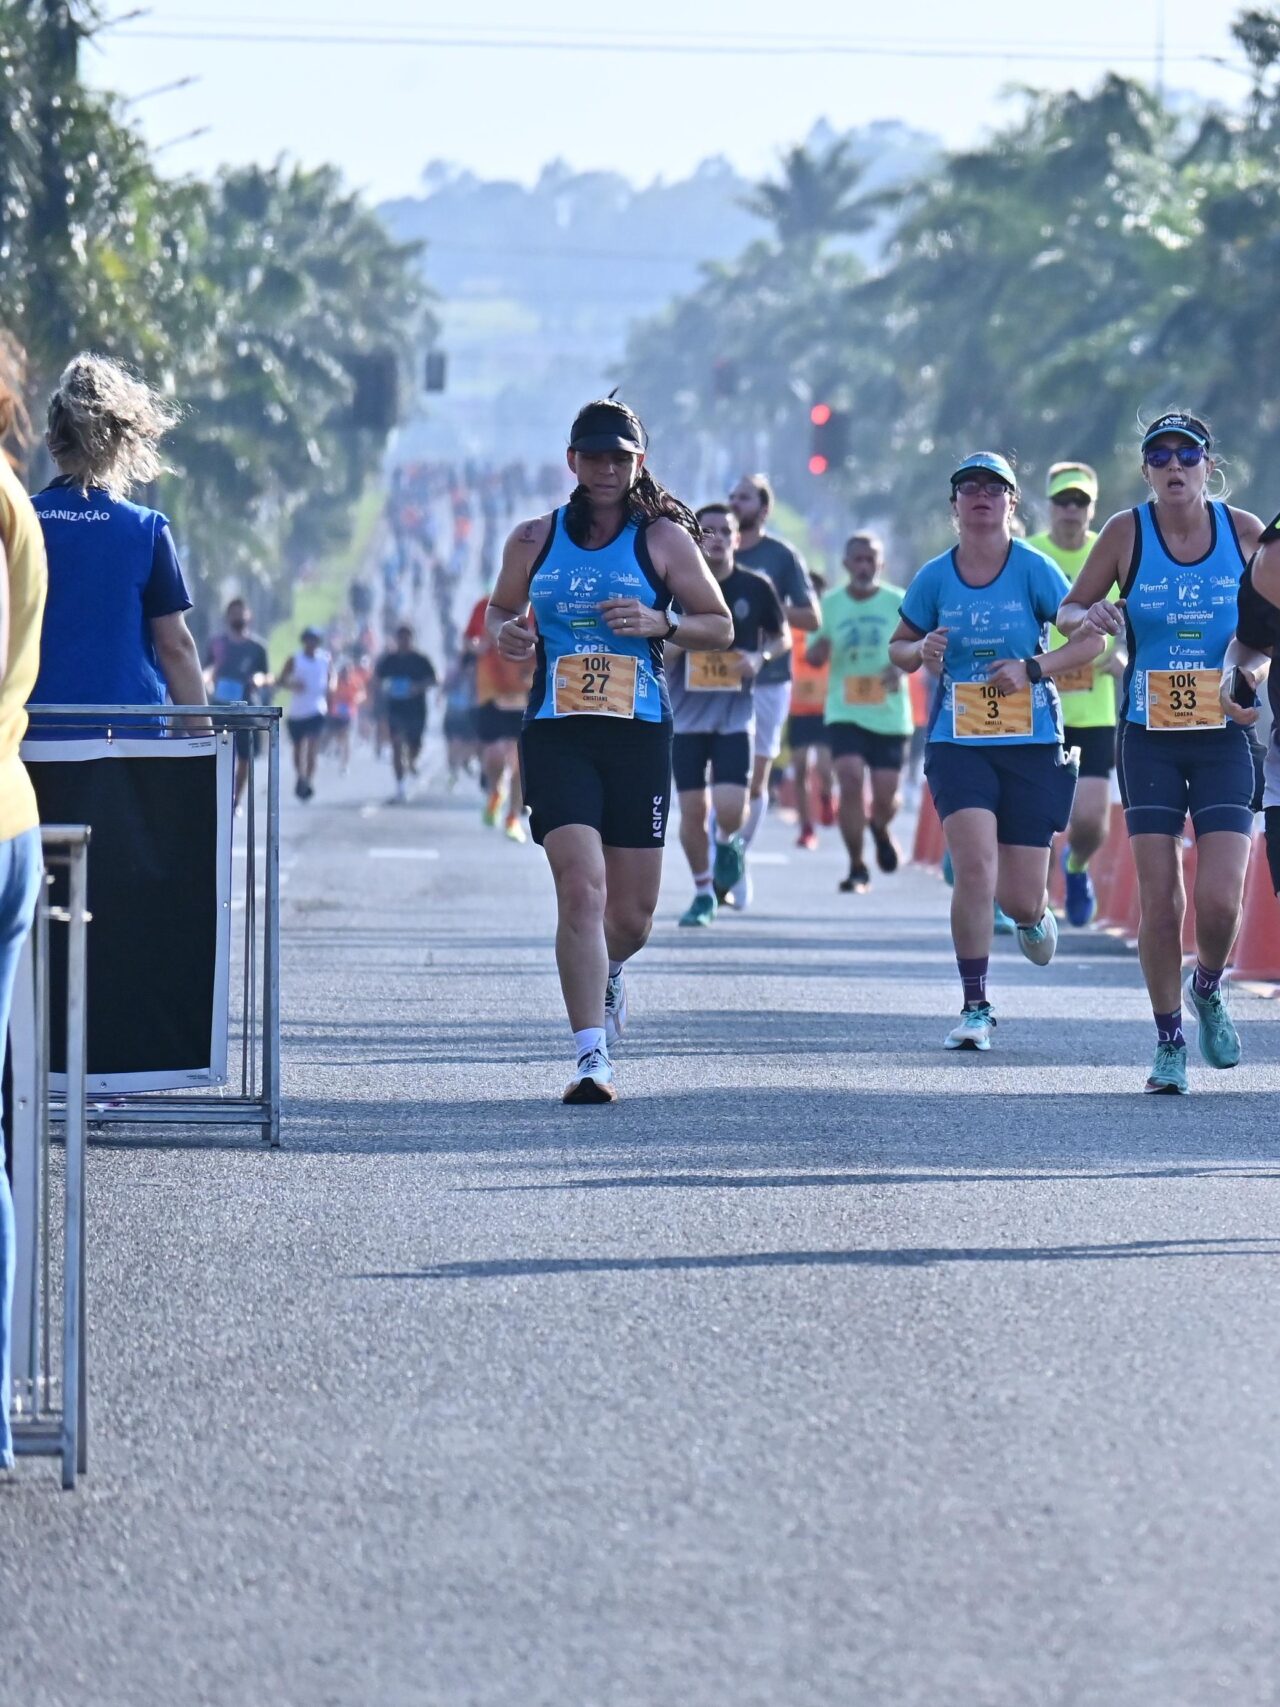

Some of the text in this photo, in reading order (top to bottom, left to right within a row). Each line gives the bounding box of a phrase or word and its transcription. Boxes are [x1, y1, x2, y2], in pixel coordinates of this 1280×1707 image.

[37, 509, 110, 523] RGANIZAÇÃO
[575, 644, 611, 653] CAPEL
[582, 657, 611, 671] 10k
[1169, 661, 1206, 670] CAPEL
[581, 674, 610, 694] 27
[1169, 673, 1197, 688] 10k
[1170, 690, 1197, 710] 33
[988, 701, 1000, 719] 3
[652, 795, 662, 838] ASICS
